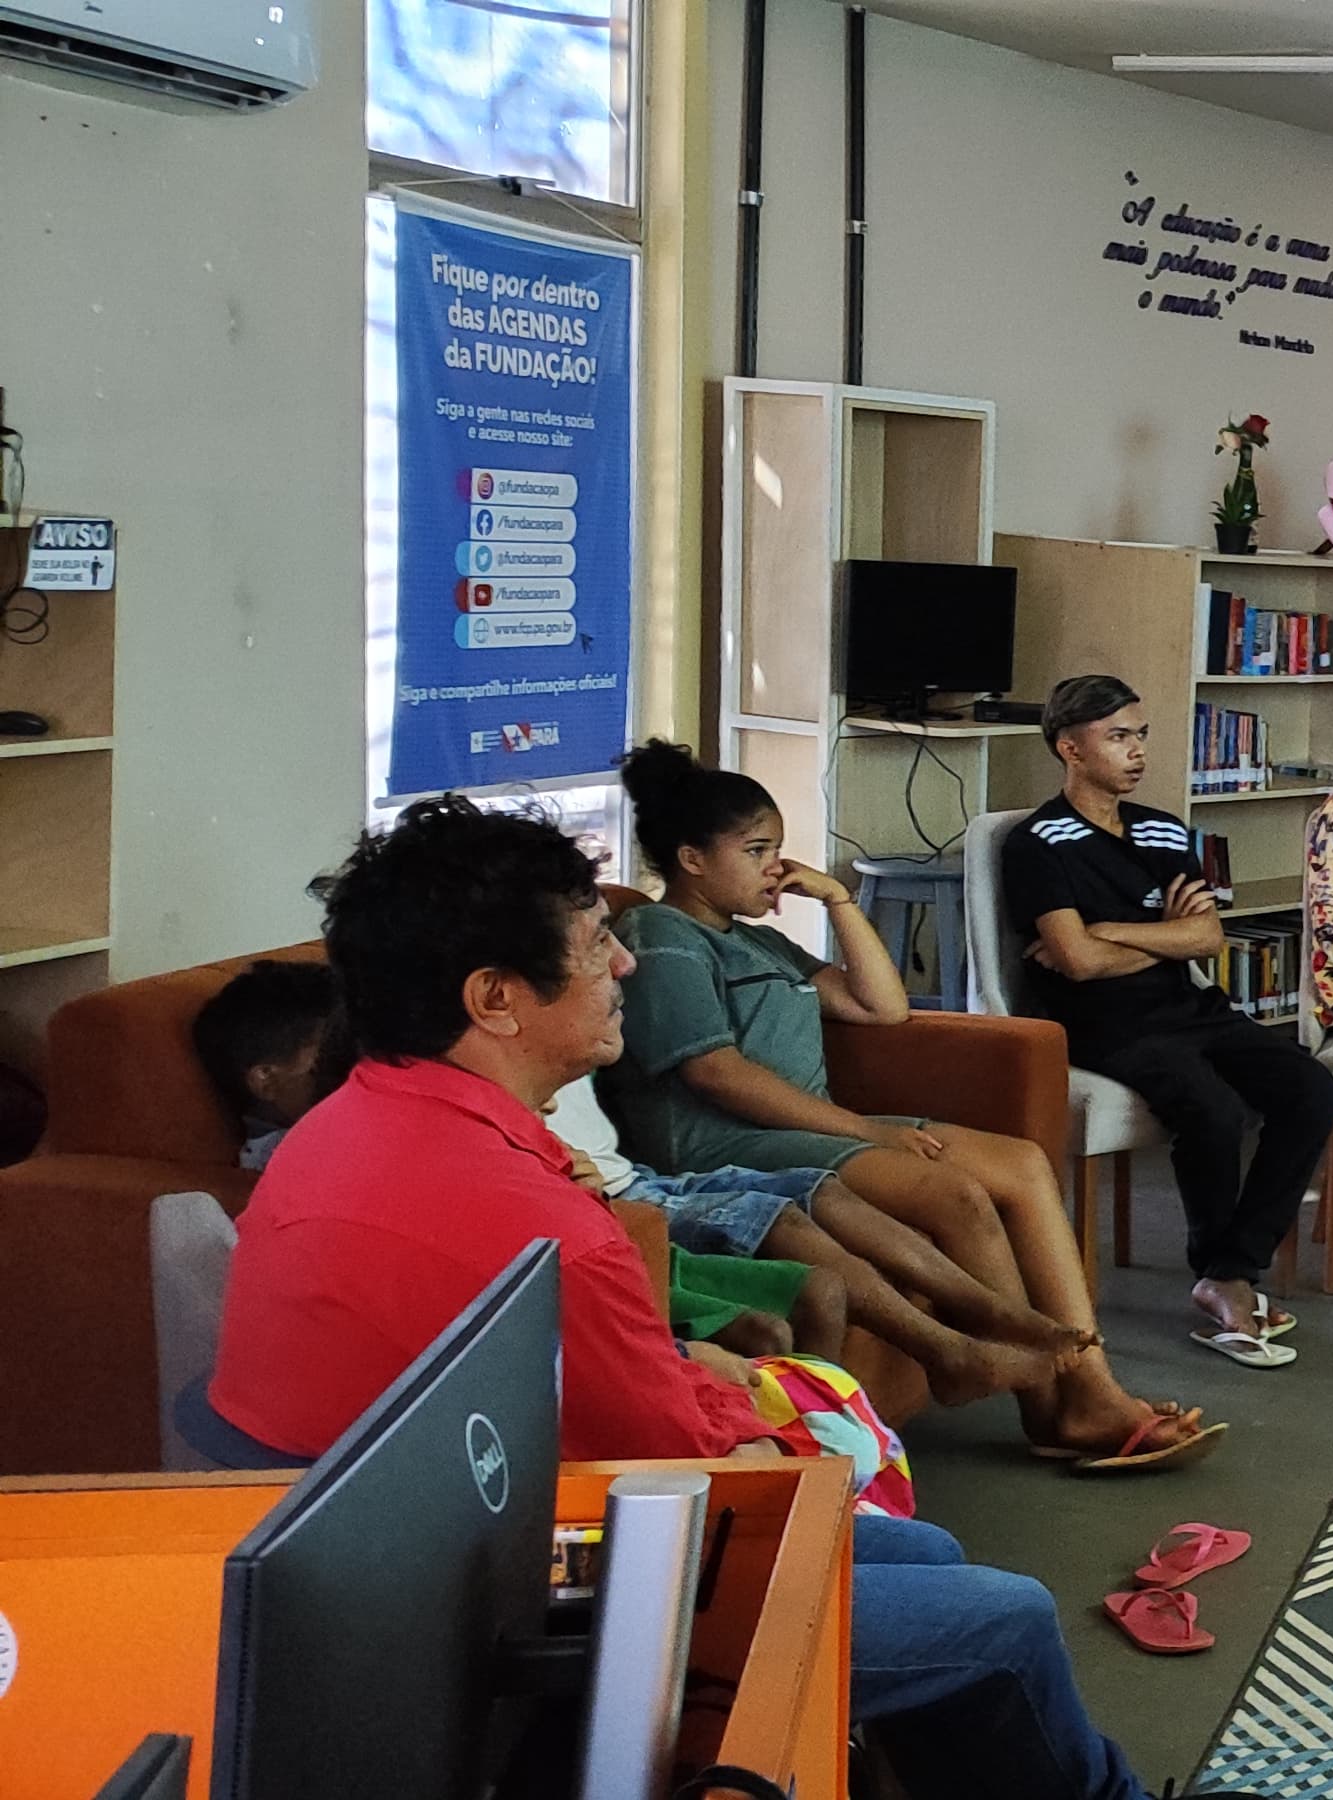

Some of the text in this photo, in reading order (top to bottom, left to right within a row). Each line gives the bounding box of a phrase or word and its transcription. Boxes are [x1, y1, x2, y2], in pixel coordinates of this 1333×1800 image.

[431, 253, 601, 311] Fique por dentro
[448, 297, 589, 347] das AGENDAS
[443, 337, 598, 389] da FUNDAÇÃO!
[436, 398, 595, 429] Siga a gente nas redes sociais
[468, 426, 574, 447] e acesse nosso site:
[37, 522, 109, 548] AVISO
[399, 684, 428, 706] Siga
[429, 688, 438, 700] e
[439, 679, 510, 702] compartilhe
[511, 676, 577, 697] informações
[476, 1441, 503, 1484] DELL
